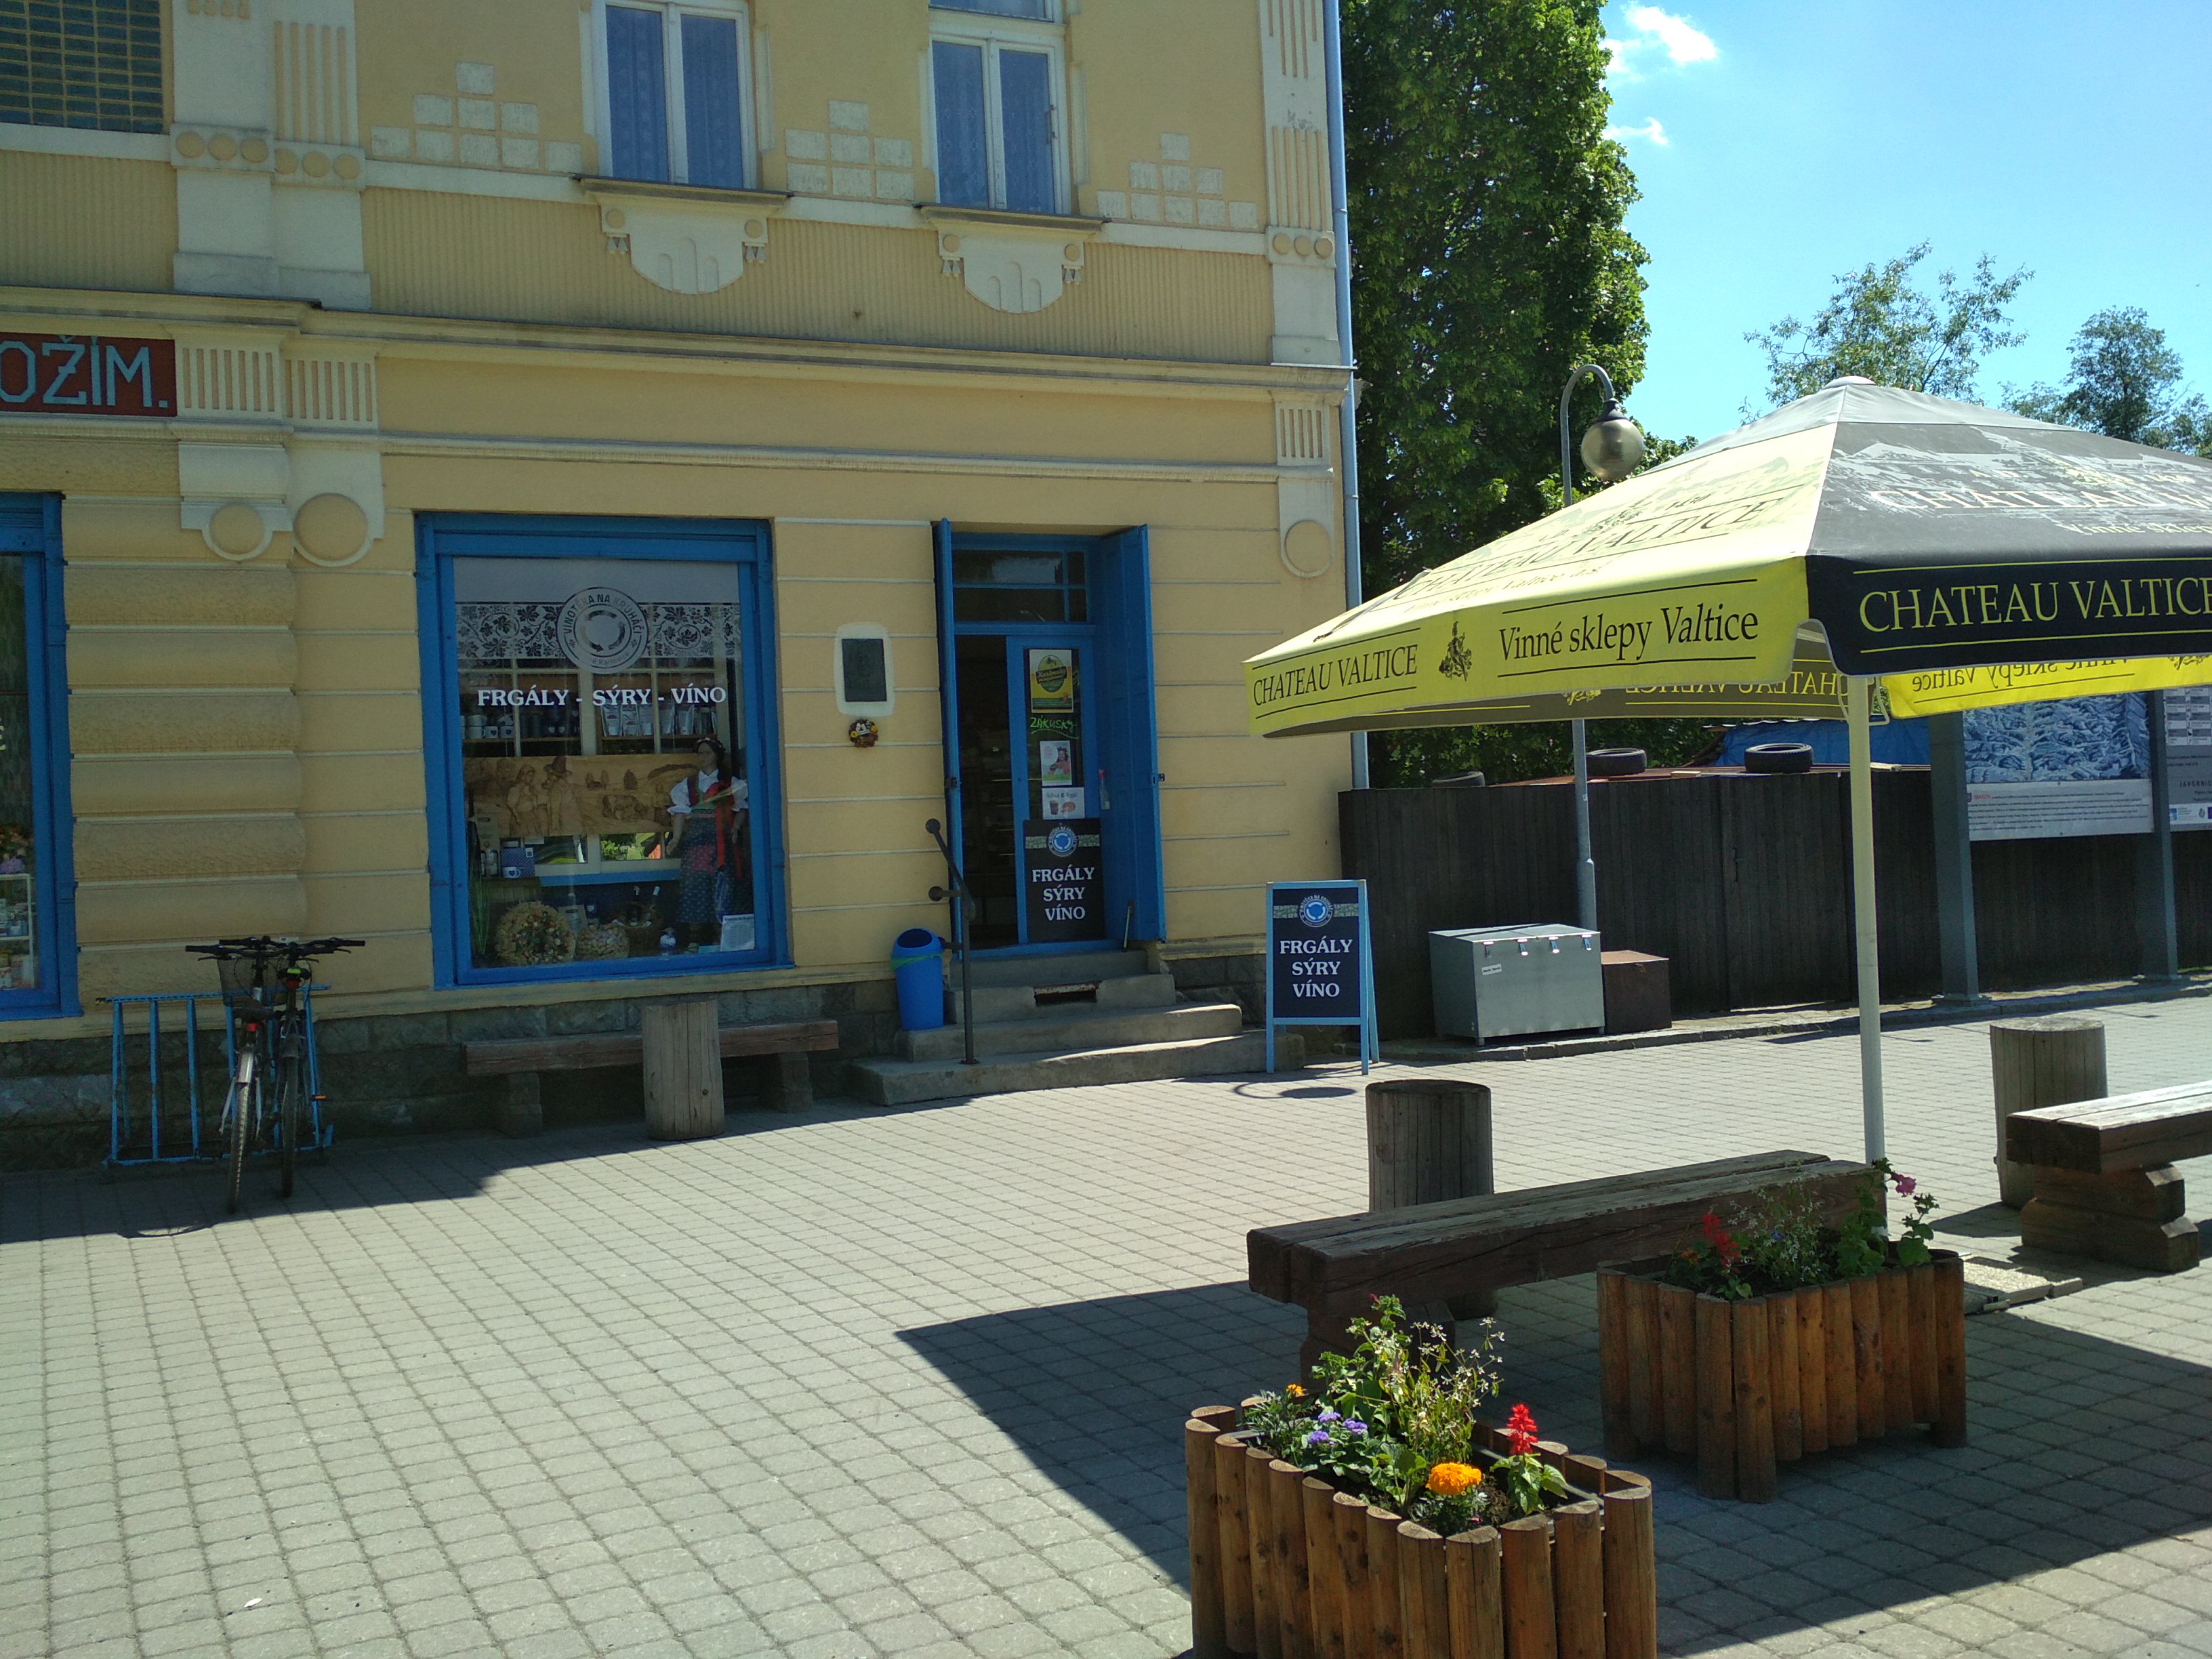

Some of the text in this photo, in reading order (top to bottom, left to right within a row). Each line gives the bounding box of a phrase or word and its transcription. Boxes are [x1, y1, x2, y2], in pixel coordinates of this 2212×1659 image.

[1870, 490, 2168, 509] CHATEAU
[1573, 497, 1786, 556] VALTICE
[596, 594, 611, 602] NA
[1859, 576, 2212, 633] CHATEAU VALTICE
[1498, 602, 1759, 664] Vinné sklepy Valtice
[1252, 643, 1418, 707] CHATEAU VALTICE
[477, 684, 569, 706] FRGÁLY
[592, 684, 652, 706] SÝRY
[671, 682, 726, 704] VÍNO
[1032, 864, 1095, 882] FRGÁLY
[1043, 884, 1085, 902] SÝRY
[1044, 903, 1086, 922] VÍNO
[1279, 935, 1353, 954] FRGÁLY
[1291, 957, 1341, 976] SÝRY
[1292, 979, 1340, 998] VÍNO
